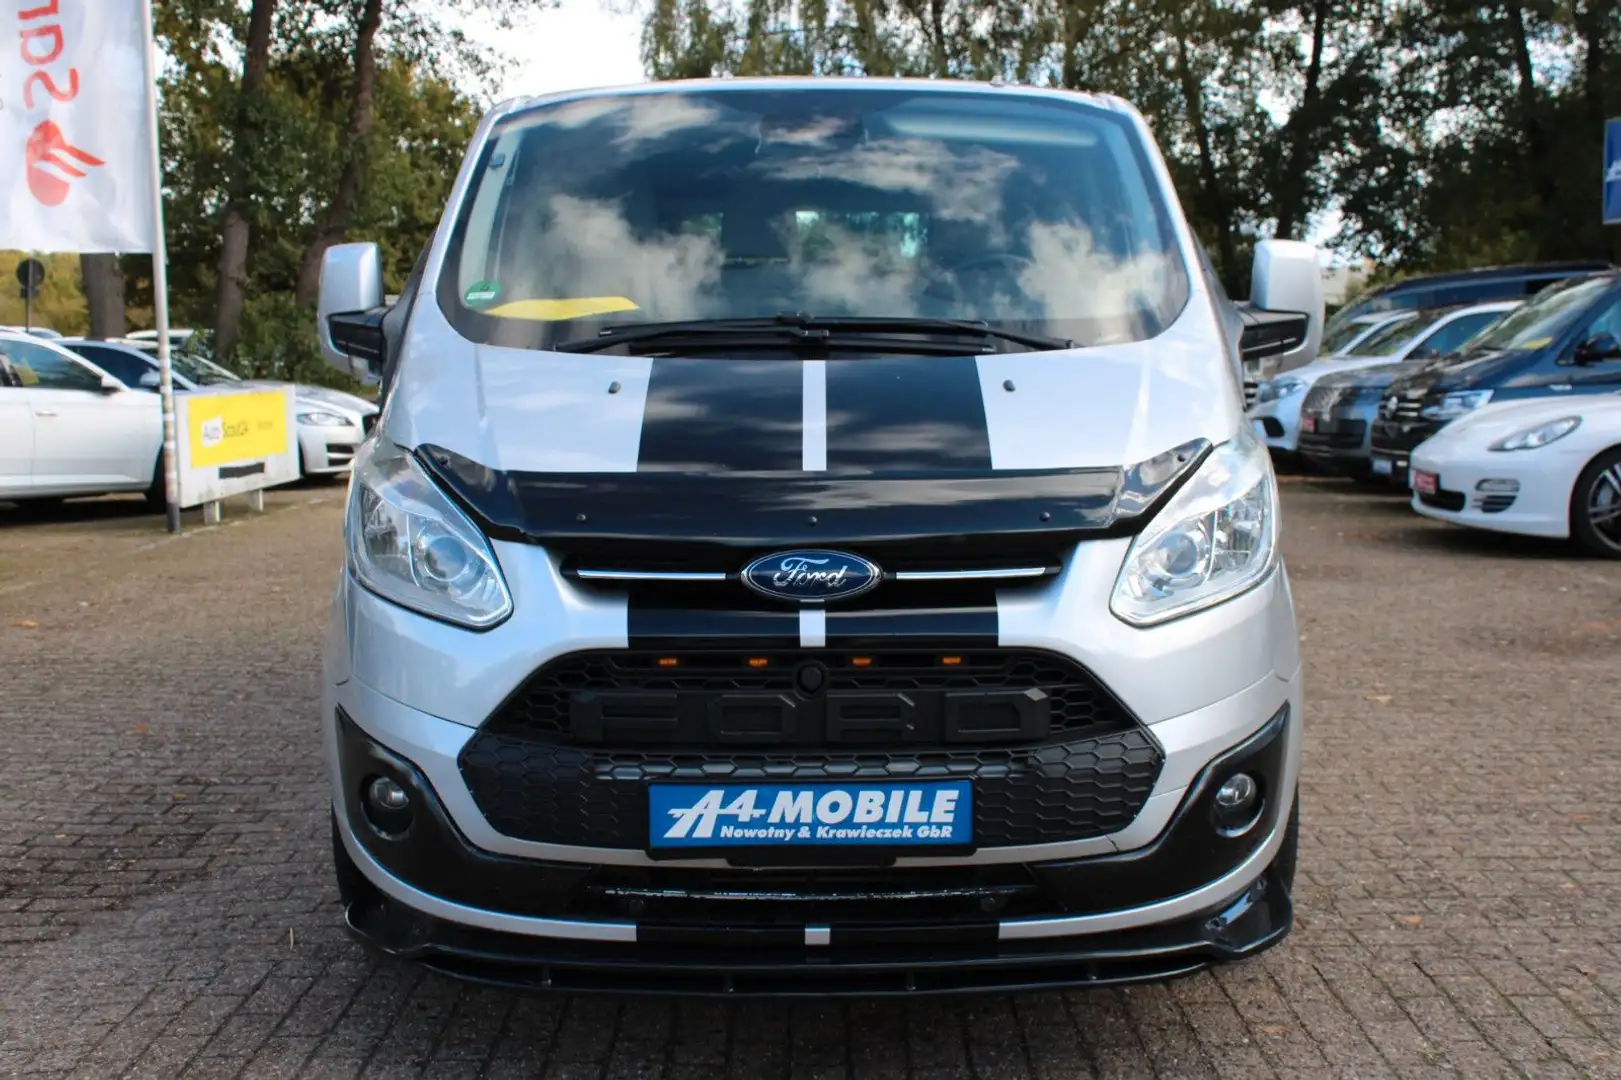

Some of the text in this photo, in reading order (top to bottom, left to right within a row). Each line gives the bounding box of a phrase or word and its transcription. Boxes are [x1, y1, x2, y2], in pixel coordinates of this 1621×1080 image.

[773, 557, 848, 587] Ford
[572, 688, 1050, 744] FORD
[720, 825, 954, 841] Nowotny & Krawieczek GbR
